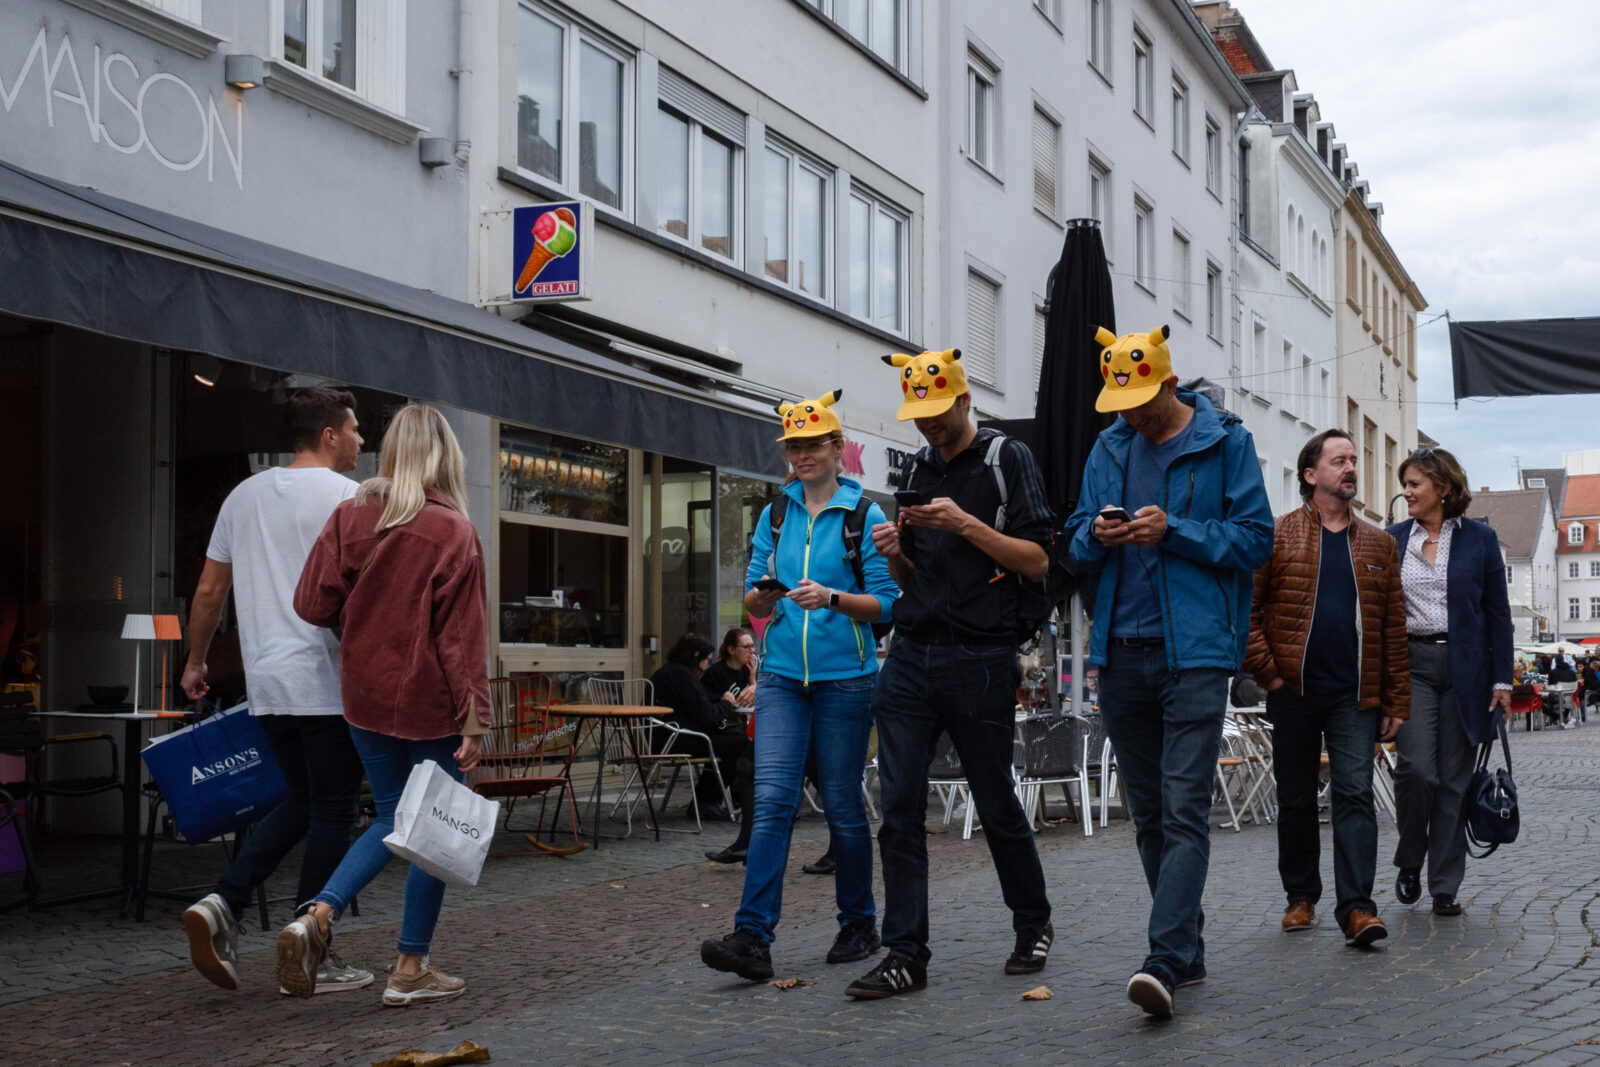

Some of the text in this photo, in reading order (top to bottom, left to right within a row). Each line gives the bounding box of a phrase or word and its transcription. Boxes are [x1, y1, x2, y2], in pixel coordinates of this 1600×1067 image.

[534, 282, 576, 294] GELATI
[192, 747, 259, 786] ANSON'S
[432, 806, 480, 839] MANGO
